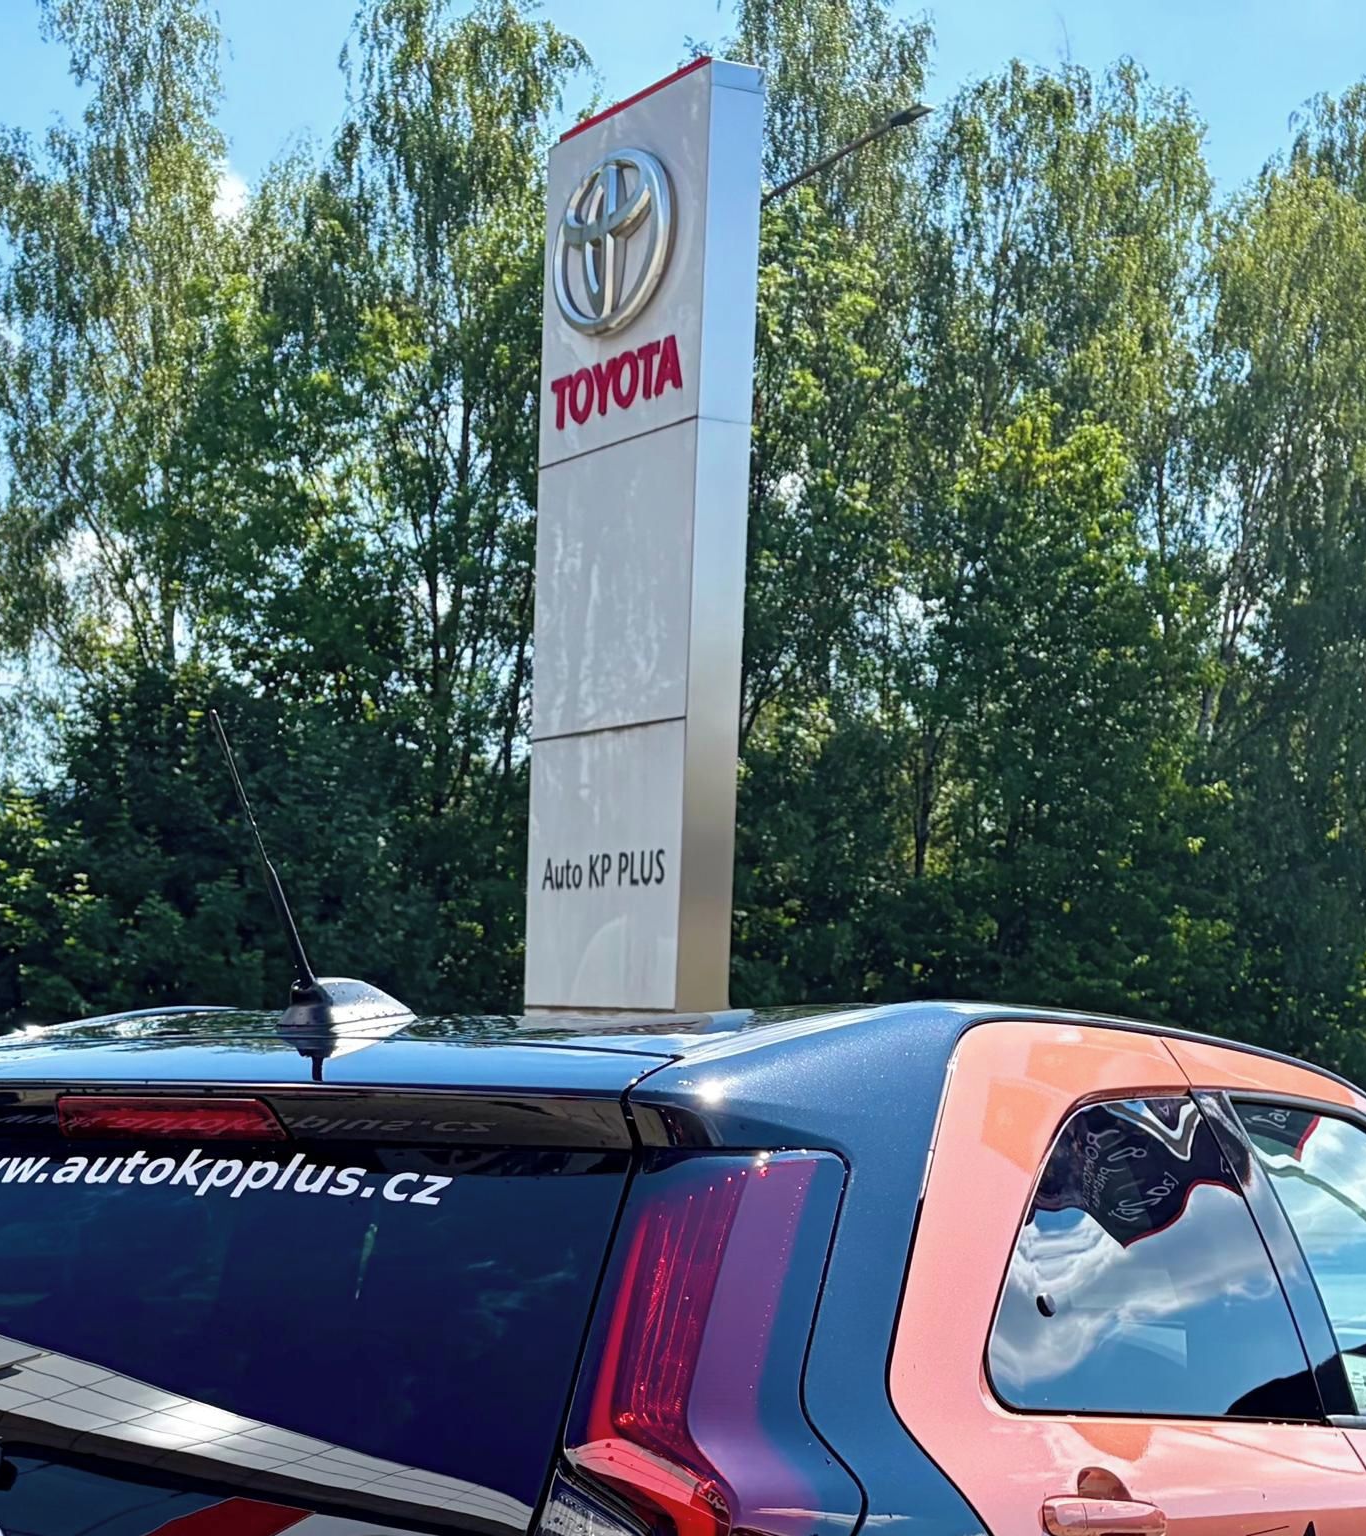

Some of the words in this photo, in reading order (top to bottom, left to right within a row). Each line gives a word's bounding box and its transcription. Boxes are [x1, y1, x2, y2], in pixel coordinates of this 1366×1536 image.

[551, 333, 683, 430] TOYOTA
[542, 857, 582, 892] Auto
[589, 852, 613, 888] KP
[618, 848, 666, 886] PLUS
